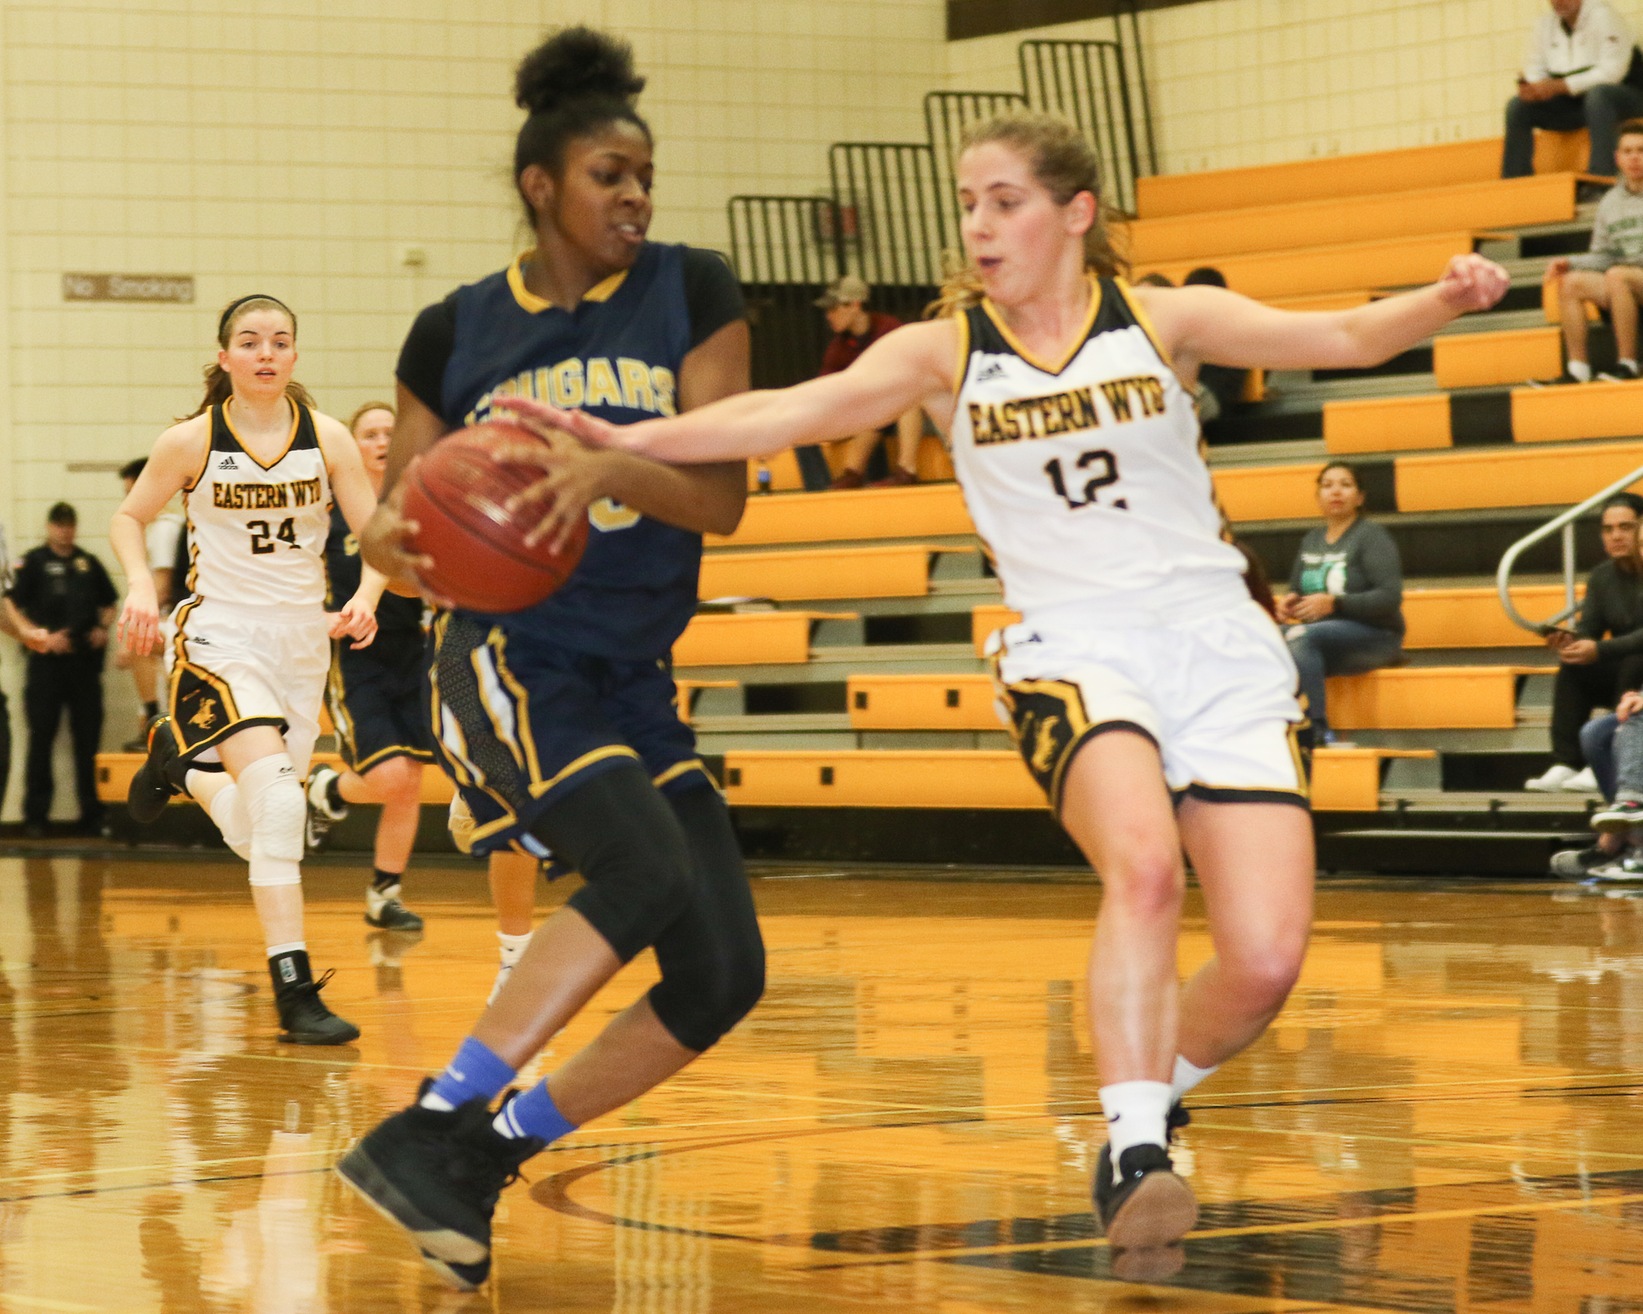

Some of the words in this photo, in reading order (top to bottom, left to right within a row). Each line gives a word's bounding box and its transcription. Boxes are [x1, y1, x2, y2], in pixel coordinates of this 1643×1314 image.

[968, 386, 1100, 446] EASTERN
[212, 482, 288, 510] EASTERN
[1043, 449, 1128, 510] 12
[246, 517, 302, 555] 24
